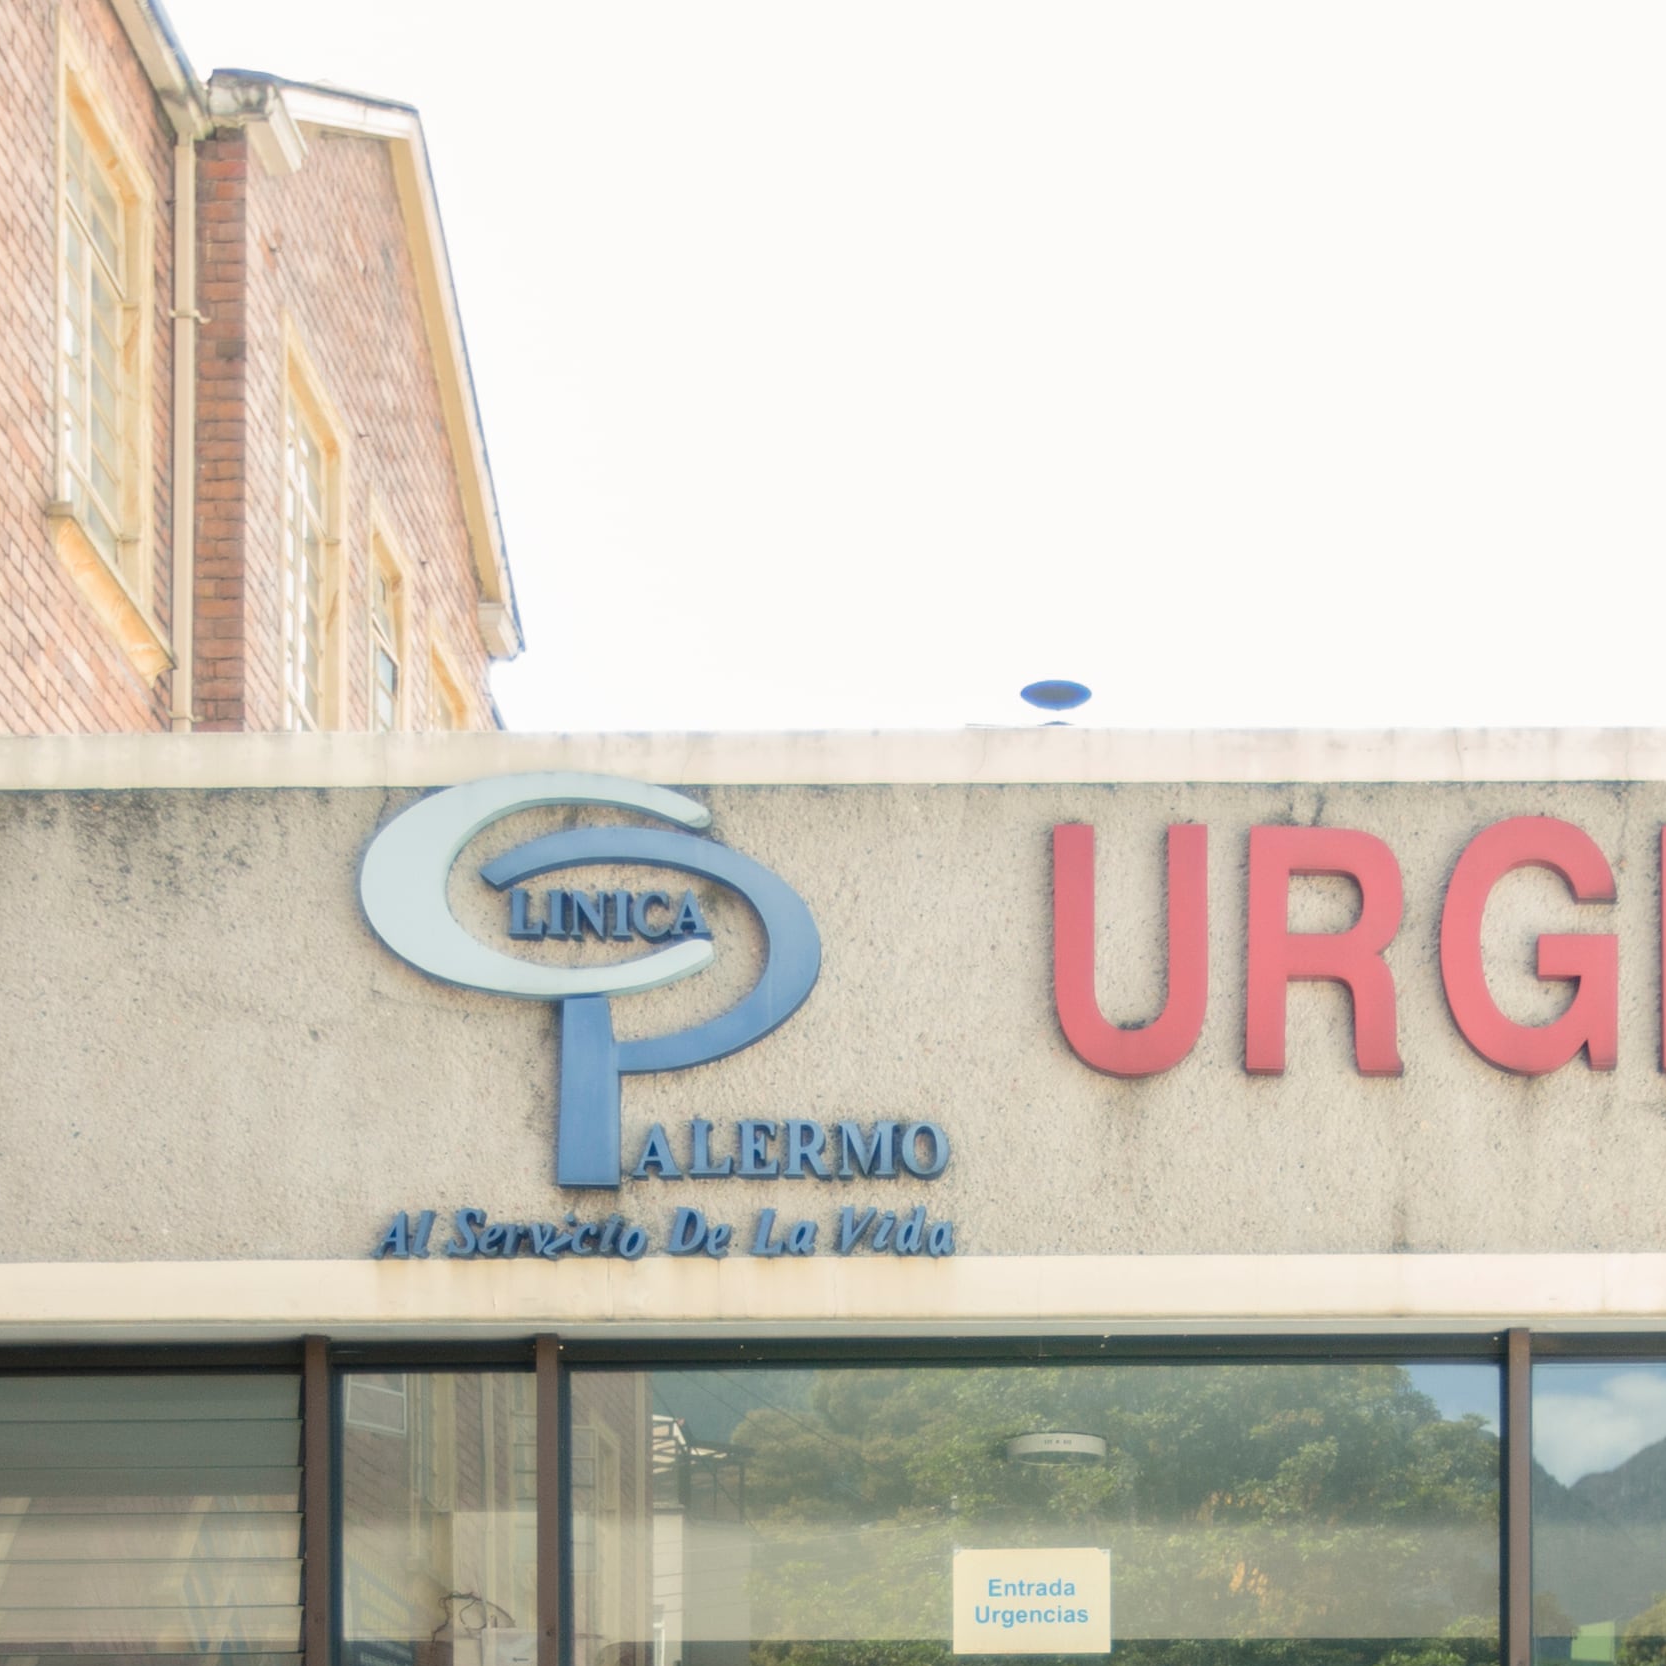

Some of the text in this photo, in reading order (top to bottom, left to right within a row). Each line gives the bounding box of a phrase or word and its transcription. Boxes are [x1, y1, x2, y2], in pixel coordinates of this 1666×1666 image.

[373, 1208, 435, 1260] Al
[668, 1206, 730, 1257] De
[751, 1206, 819, 1257] La
[840, 1205, 956, 1258] Vida
[987, 1578, 1076, 1598] Entrada
[974, 1605, 1089, 1628] Urgencias
